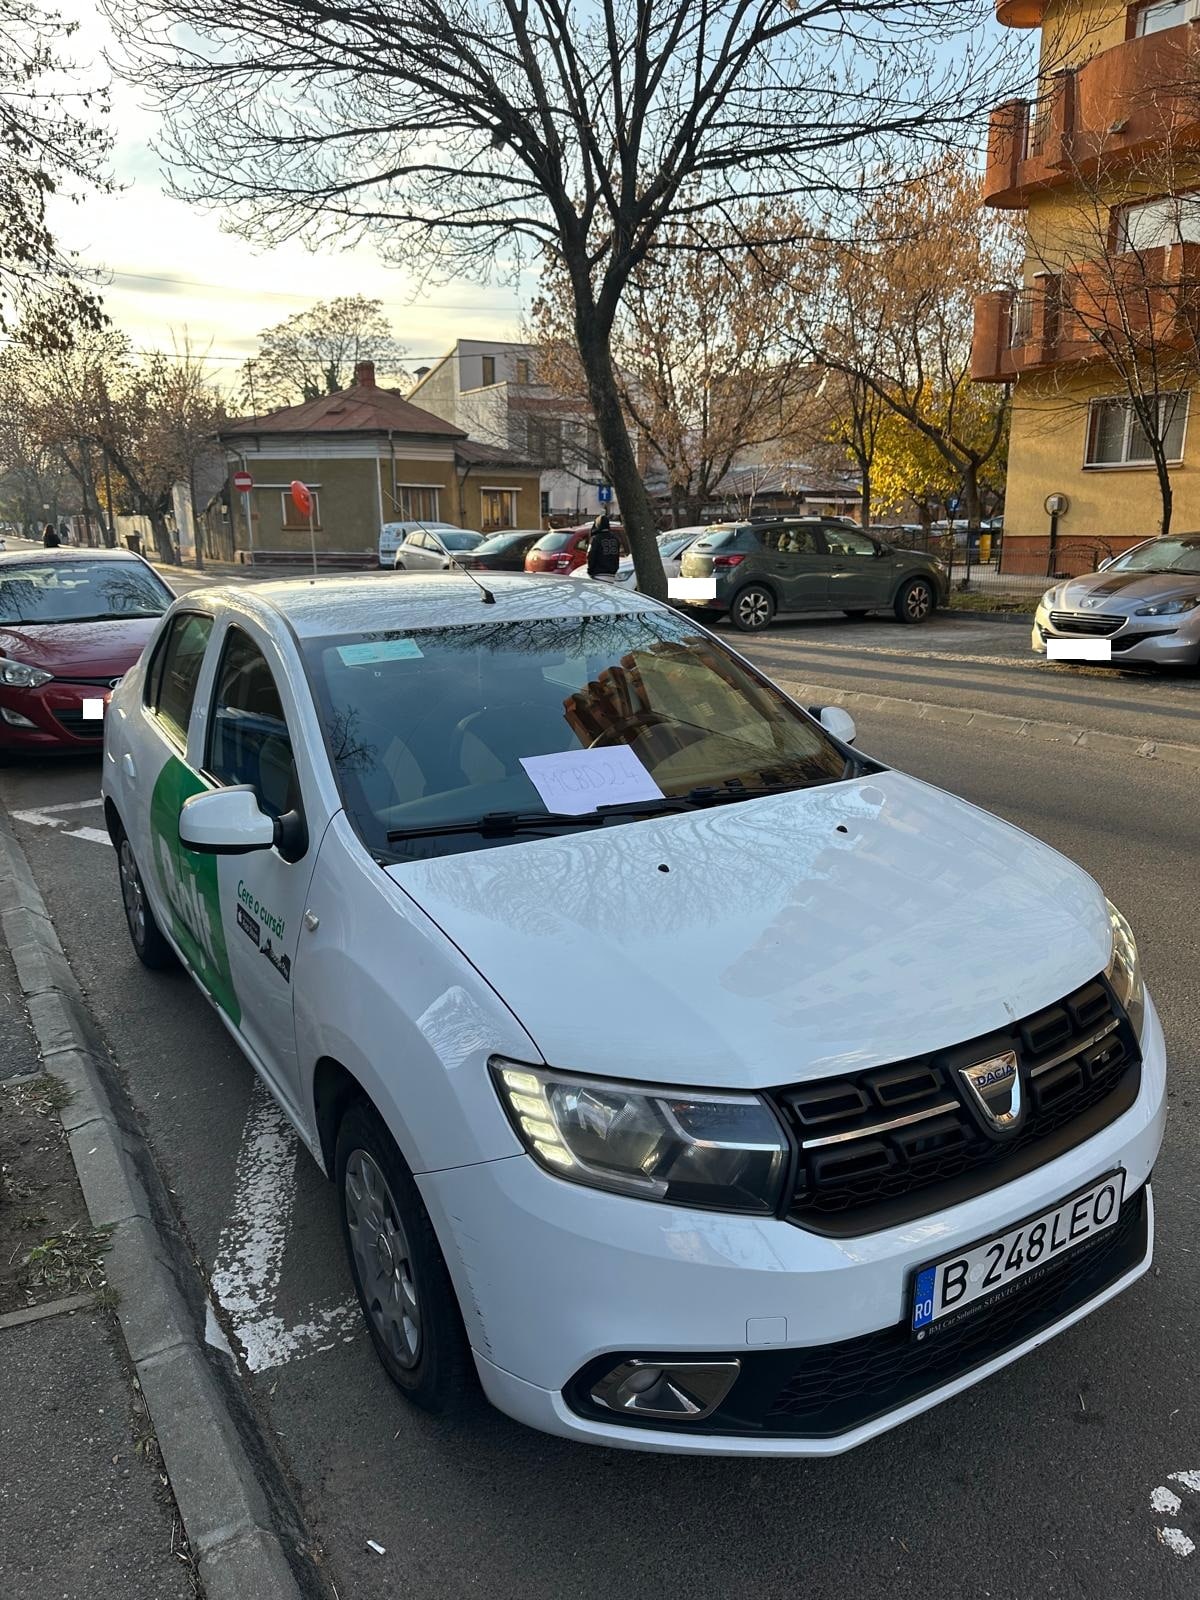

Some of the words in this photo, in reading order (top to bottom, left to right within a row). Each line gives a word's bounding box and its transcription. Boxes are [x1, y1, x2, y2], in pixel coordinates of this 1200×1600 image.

[237, 879, 254, 911] Cere
[254, 900, 260, 915] o
[260, 905, 285, 941] cursă!
[976, 1064, 1014, 1087] DACIA
[941, 1259, 969, 1309] B
[942, 1317, 955, 1328] Car
[955, 1304, 982, 1321] Solution
[984, 1284, 1020, 1308] SERVICE
[1021, 1269, 1045, 1288] AUTO
[915, 1299, 932, 1322] RO
